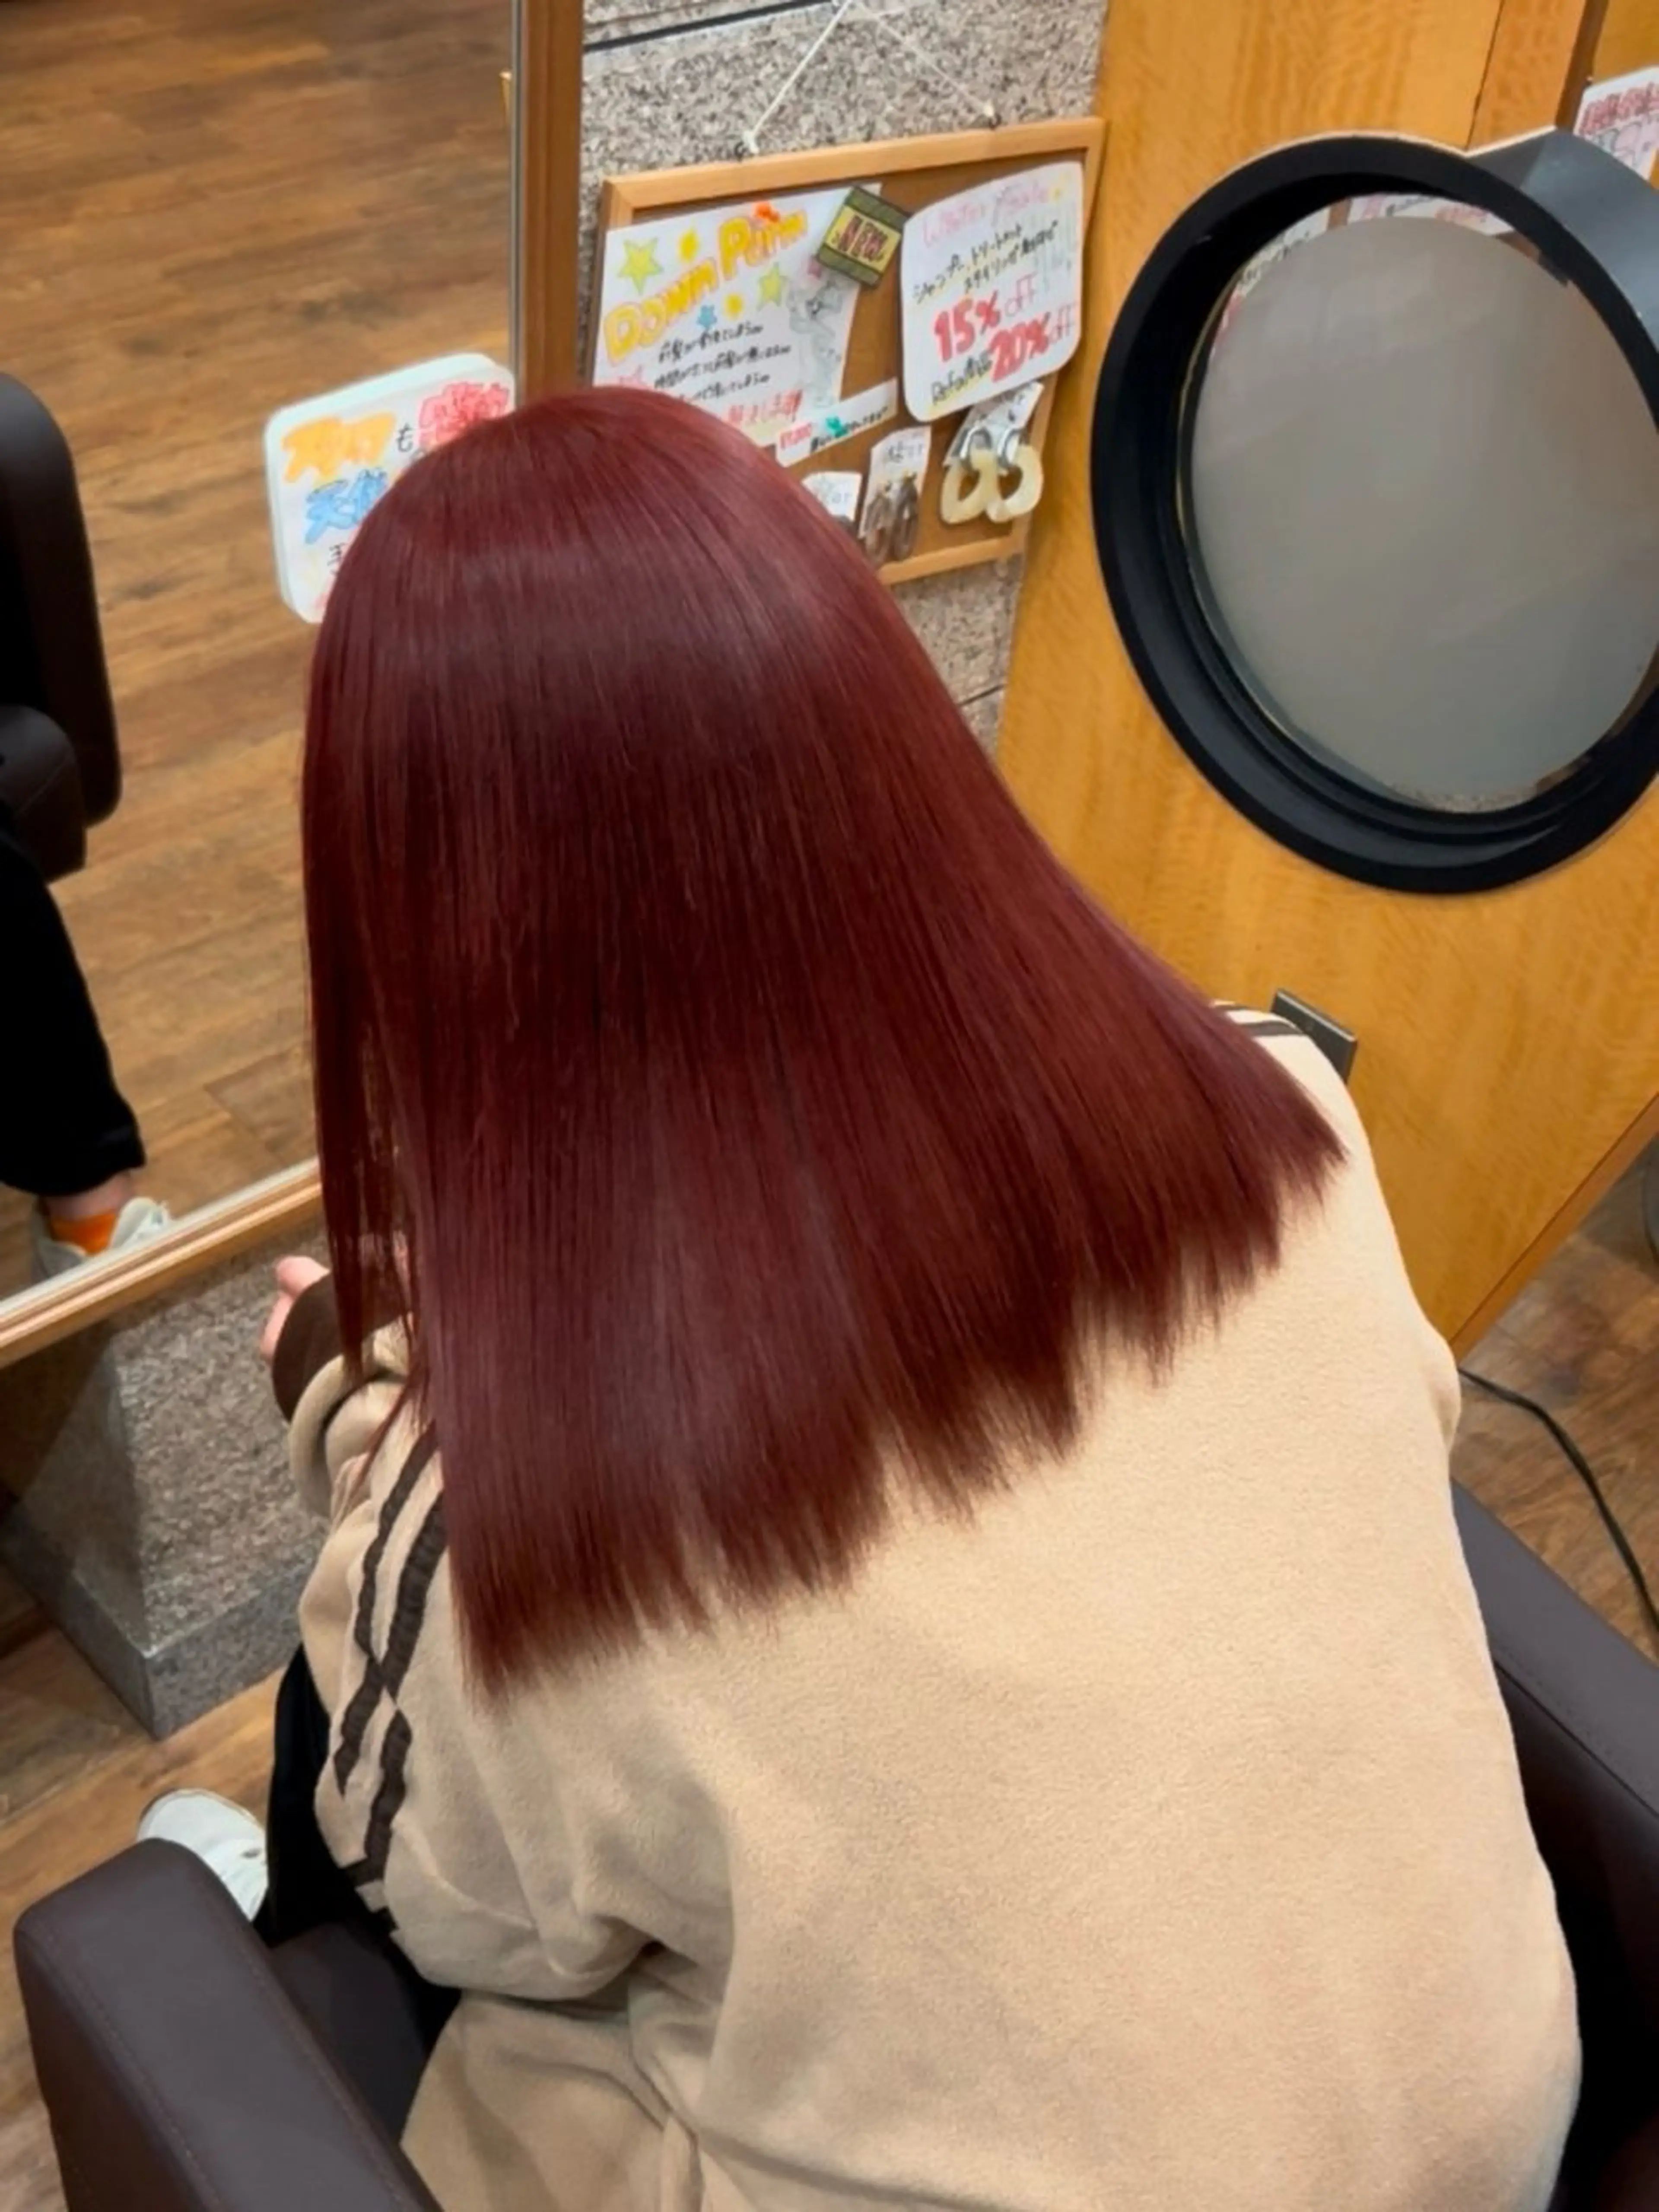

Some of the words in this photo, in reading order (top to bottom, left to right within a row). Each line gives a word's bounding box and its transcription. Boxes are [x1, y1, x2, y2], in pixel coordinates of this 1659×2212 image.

[837, 214, 889, 263] NEW
[934, 289, 1001, 362] 15%
[988, 311, 1052, 381] 20%
